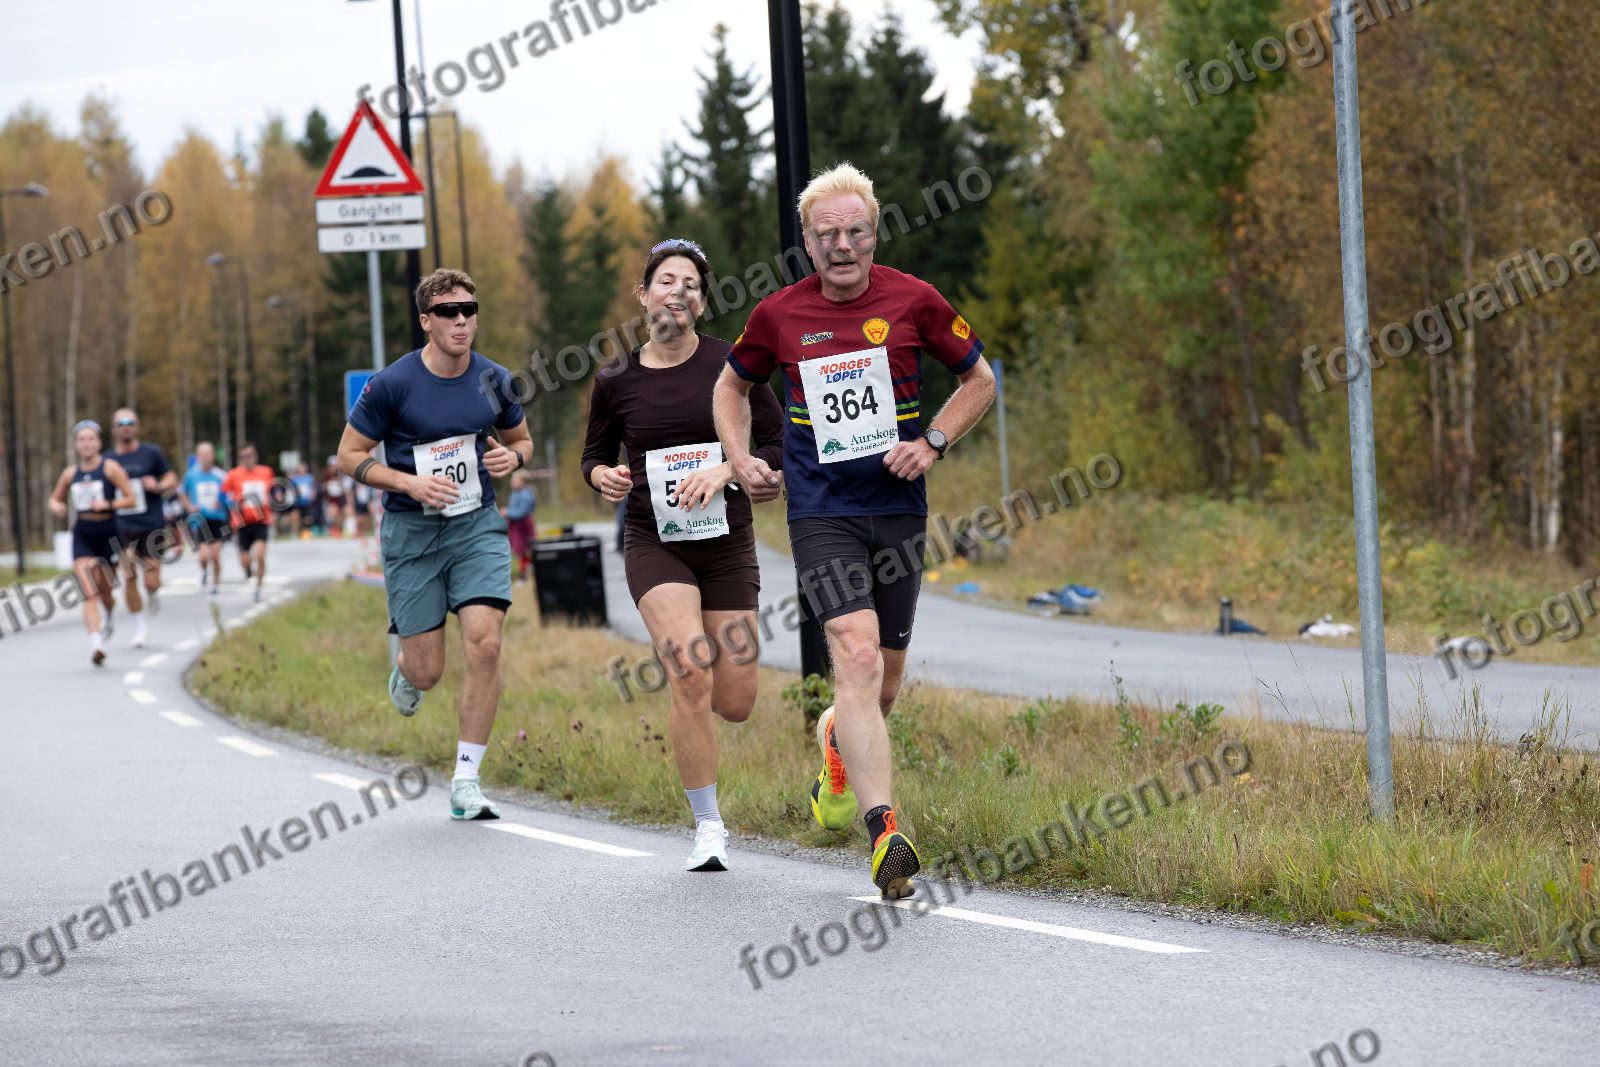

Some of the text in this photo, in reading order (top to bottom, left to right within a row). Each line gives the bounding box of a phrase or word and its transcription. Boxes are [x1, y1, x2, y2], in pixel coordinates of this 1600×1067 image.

[344, 233, 353, 246] 0
[379, 231, 402, 244] km
[820, 357, 872, 374] NORGES
[826, 368, 864, 384] LØPET
[823, 386, 879, 424] 364
[851, 428, 897, 446] Aurskog
[430, 439, 465, 455] NORGES
[434, 449, 460, 461] LØPET
[665, 450, 709, 463] NORGES
[667, 460, 702, 472] LØPET
[685, 516, 725, 529] Aurskog
